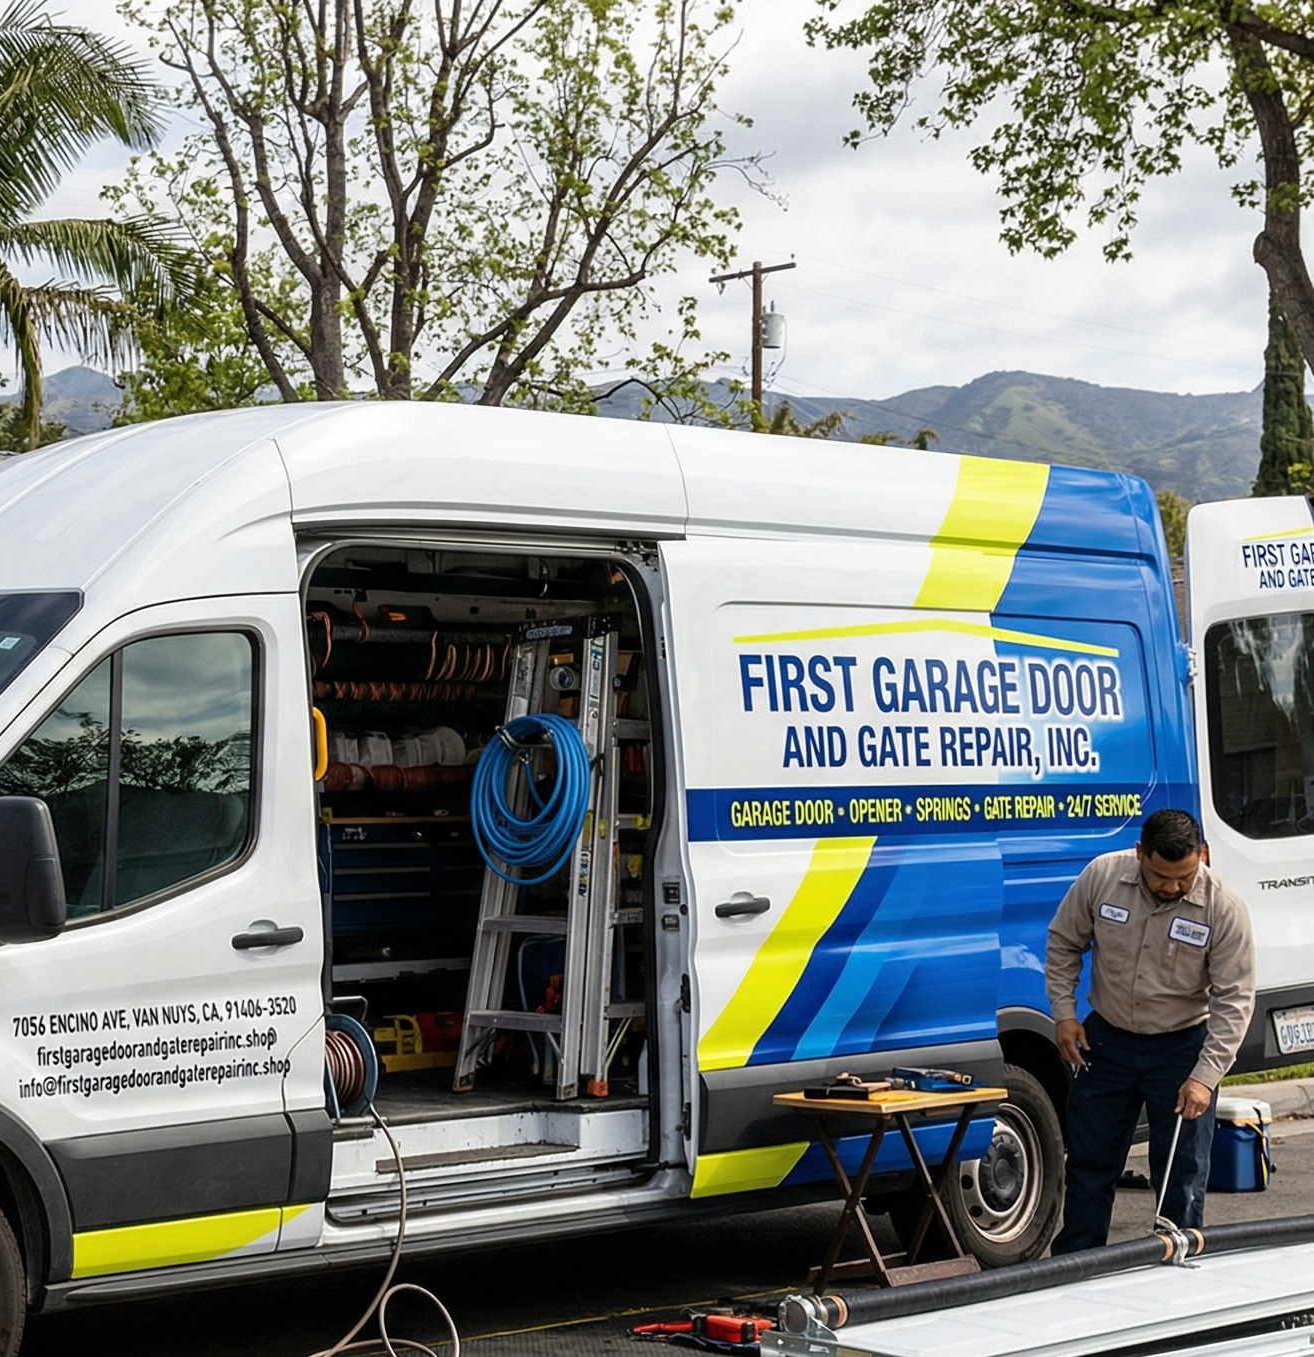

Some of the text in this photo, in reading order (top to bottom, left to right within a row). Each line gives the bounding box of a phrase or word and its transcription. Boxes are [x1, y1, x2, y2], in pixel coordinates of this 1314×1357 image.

[1242, 544, 1285, 568] FIRST
[1259, 570, 1285, 589] AND
[738, 654, 1121, 716] FIRST GARAGE DOOR
[782, 726, 1097, 776] AND GATE REPAIR, INC.
[730, 794, 1142, 827] GARAGE DOOR OPENER SPRINGS GATE REPAIR 24/7 SERVICE
[12, 996, 297, 1037] 7056 ENCINO AVE, VAN NUYS, CA, 91406-3520
[18, 1056, 291, 1098] info@firstgaragedoorandgaterepairinc.shop
